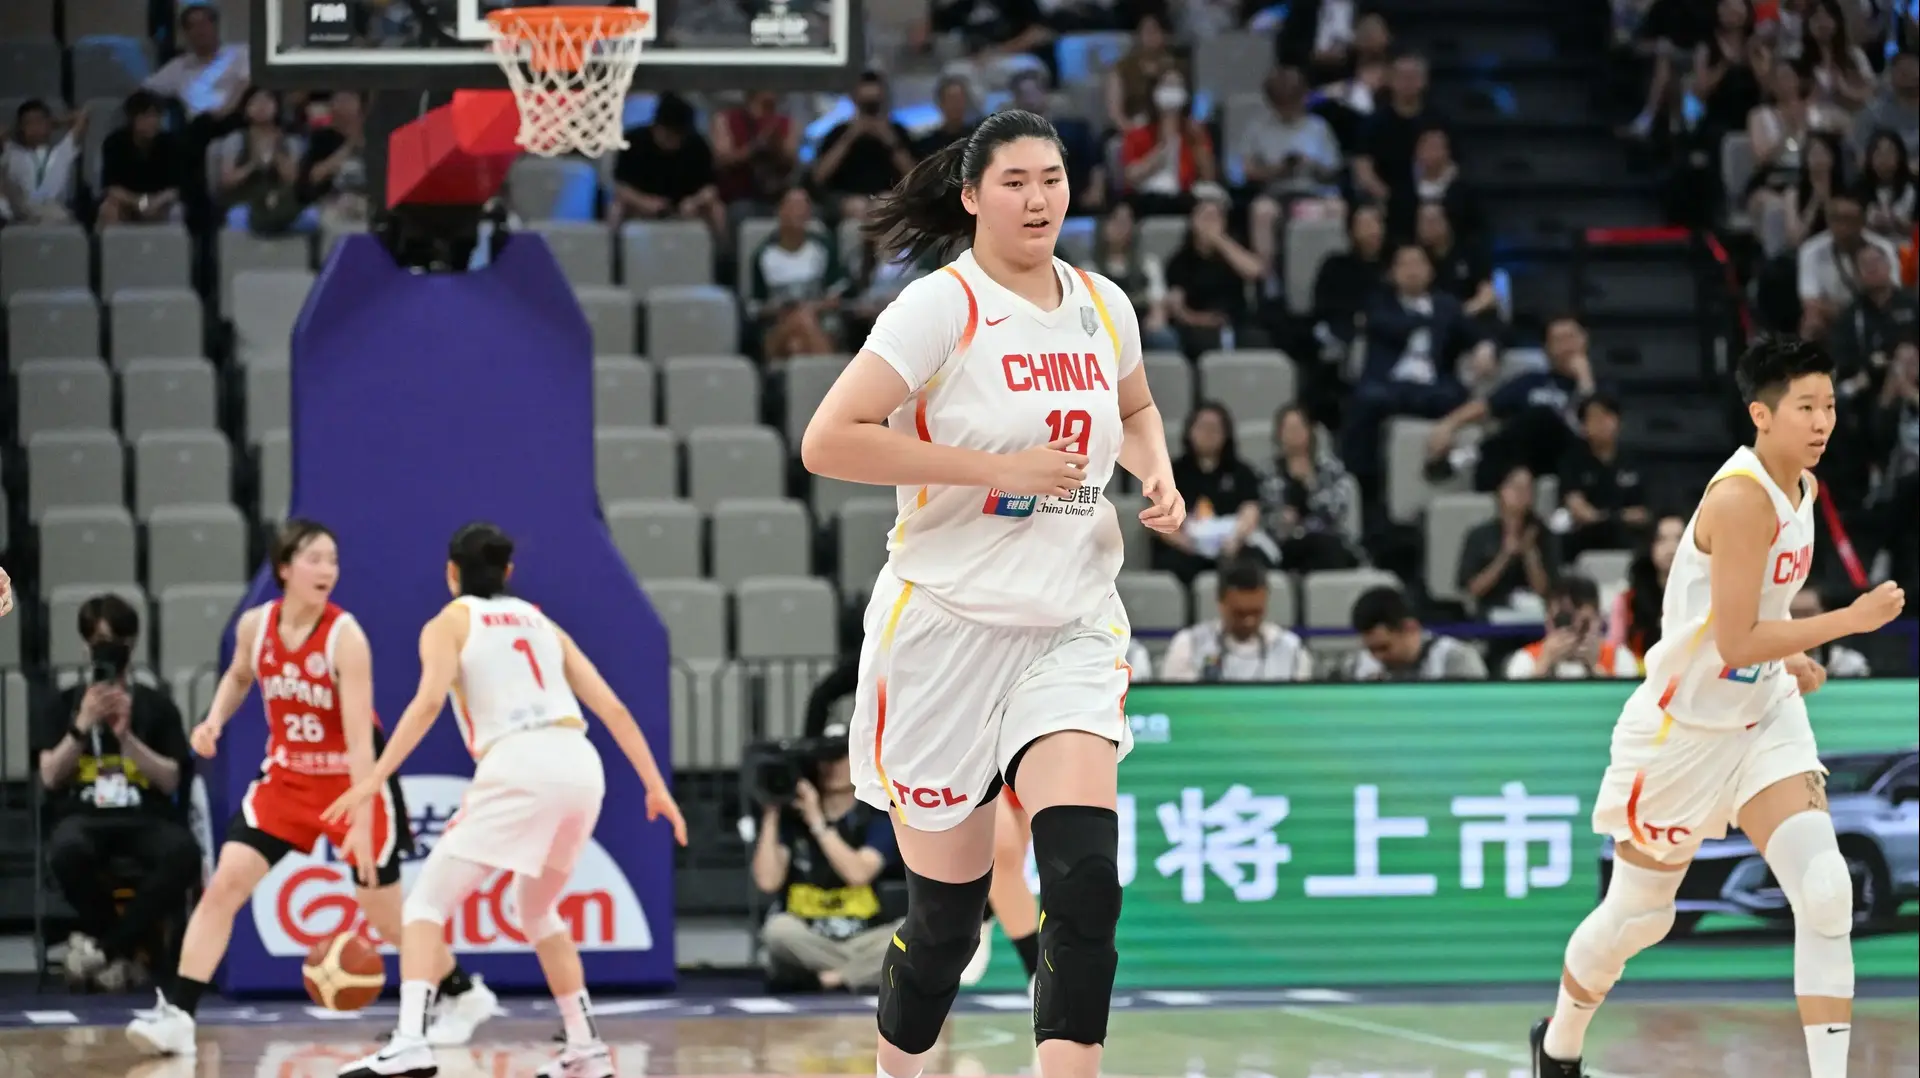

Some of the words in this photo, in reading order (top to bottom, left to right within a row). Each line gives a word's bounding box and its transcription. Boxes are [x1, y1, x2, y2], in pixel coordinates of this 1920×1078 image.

[311, 3, 347, 22] FIBA
[1001, 352, 1110, 392] CHINA
[512, 637, 545, 692] 1
[262, 674, 334, 710] JAPAN
[283, 712, 325, 743] 26
[892, 779, 968, 808] TCL
[1024, 781, 1581, 903] 将上市
